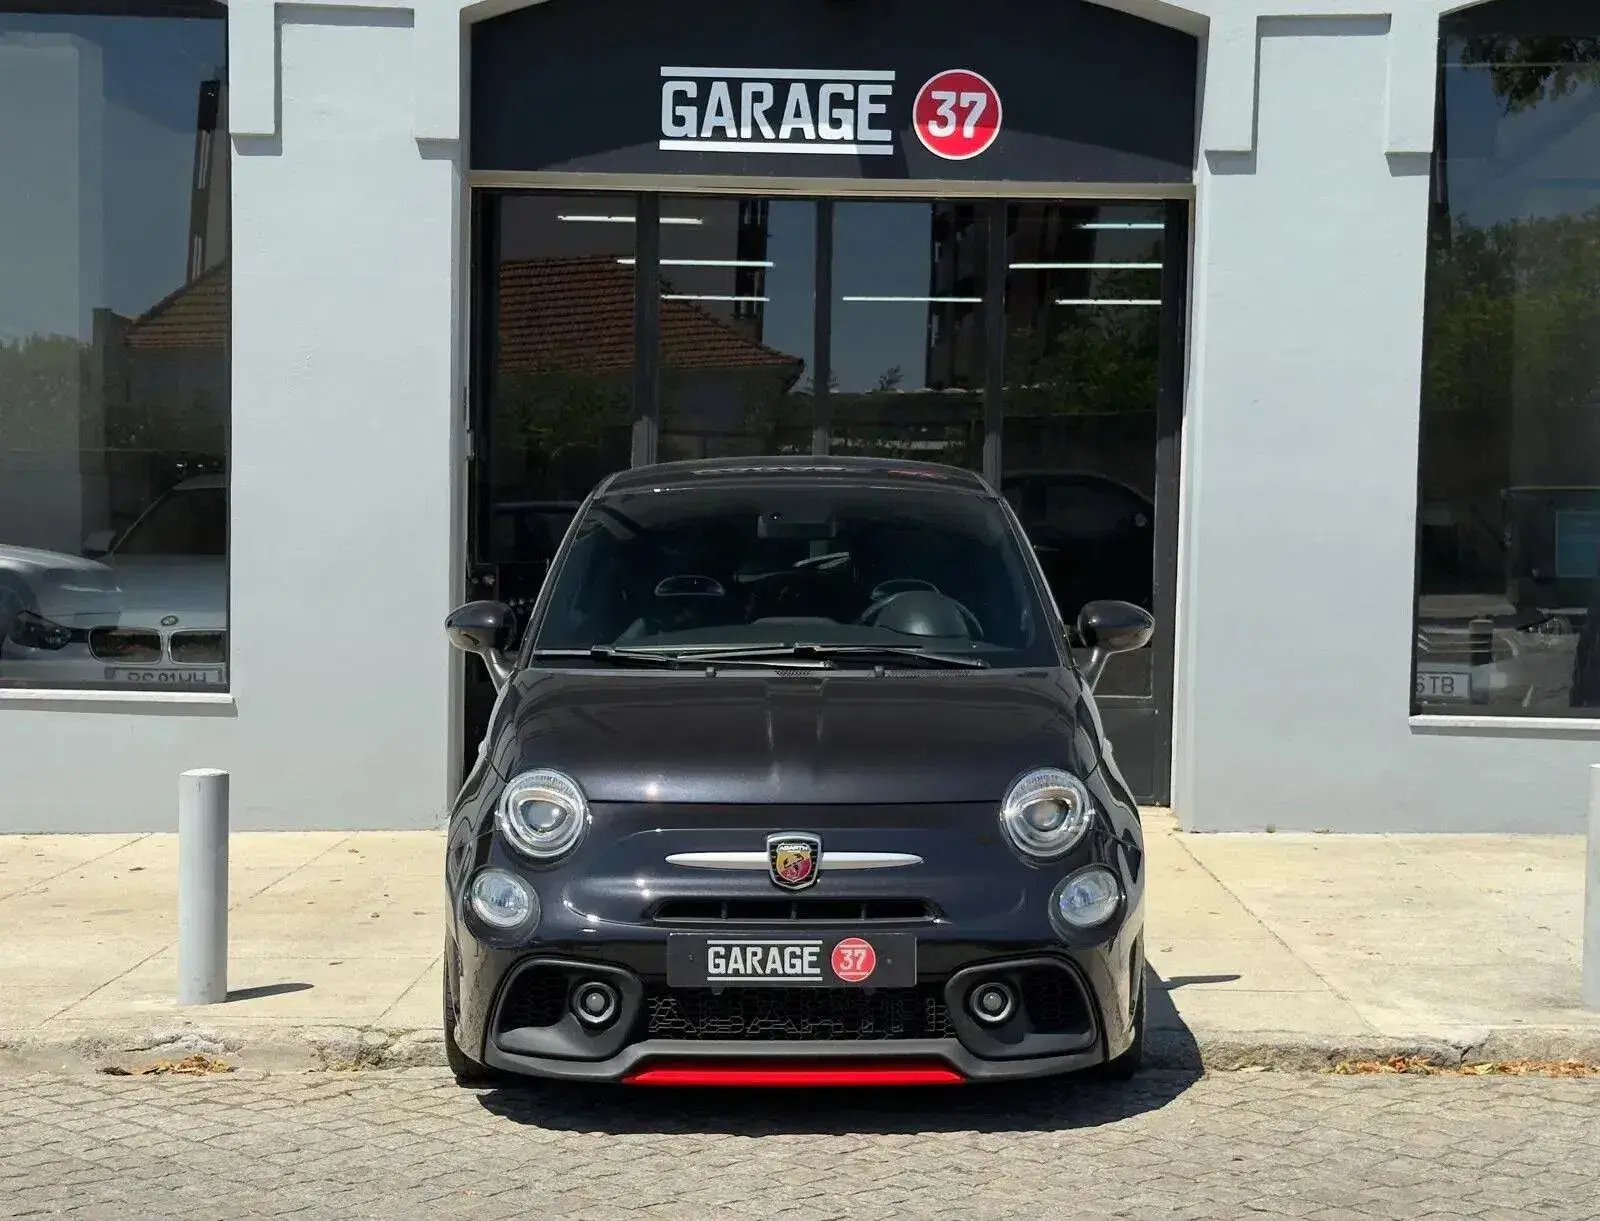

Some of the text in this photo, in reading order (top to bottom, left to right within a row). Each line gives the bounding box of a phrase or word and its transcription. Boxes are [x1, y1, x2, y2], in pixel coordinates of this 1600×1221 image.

[661, 81, 988, 141] GARAGE 37
[707, 946, 866, 975] GARAGE 37
